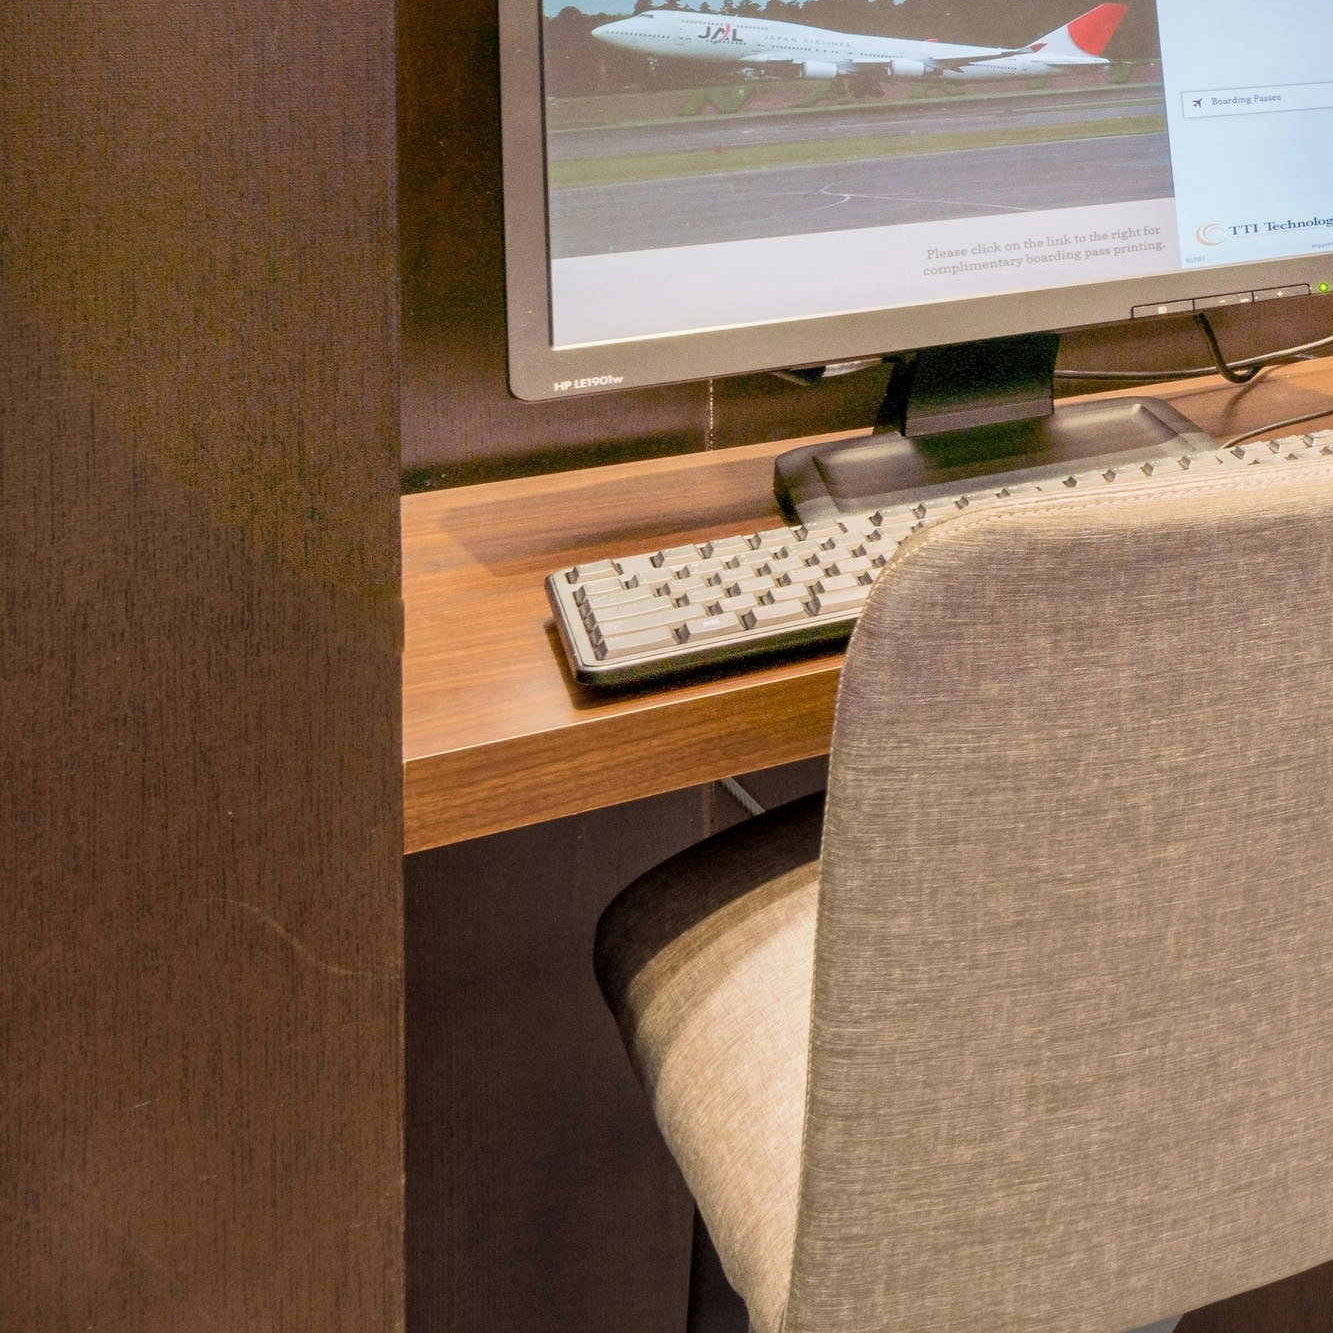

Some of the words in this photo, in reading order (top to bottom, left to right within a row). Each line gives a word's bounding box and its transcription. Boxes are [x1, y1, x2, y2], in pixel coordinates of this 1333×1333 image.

[697, 23, 744, 43] JAL
[763, 35, 798, 44] JAPAN
[803, 39, 852, 48] AIRLINES
[1211, 95, 1252, 106] Boarding
[1254, 94, 1282, 103] Passes
[1229, 222, 1258, 236] TTI
[926, 248, 969, 260] Please
[970, 241, 1001, 254] click
[1004, 242, 1021, 251] on
[1024, 237, 1044, 249] the
[1046, 234, 1072, 247] link
[1074, 234, 1087, 243] to
[1089, 231, 1109, 242] the
[1111, 227, 1141, 241] right
[1143, 225, 1161, 236] for
[922, 256, 1024, 276] complimentary
[1026, 249, 1081, 264] boarding
[1084, 246, 1111, 260] pass
[1113, 241, 1166, 257] printing.
[554, 380, 573, 392] HP
[574, 375, 624, 389] LE1901w
